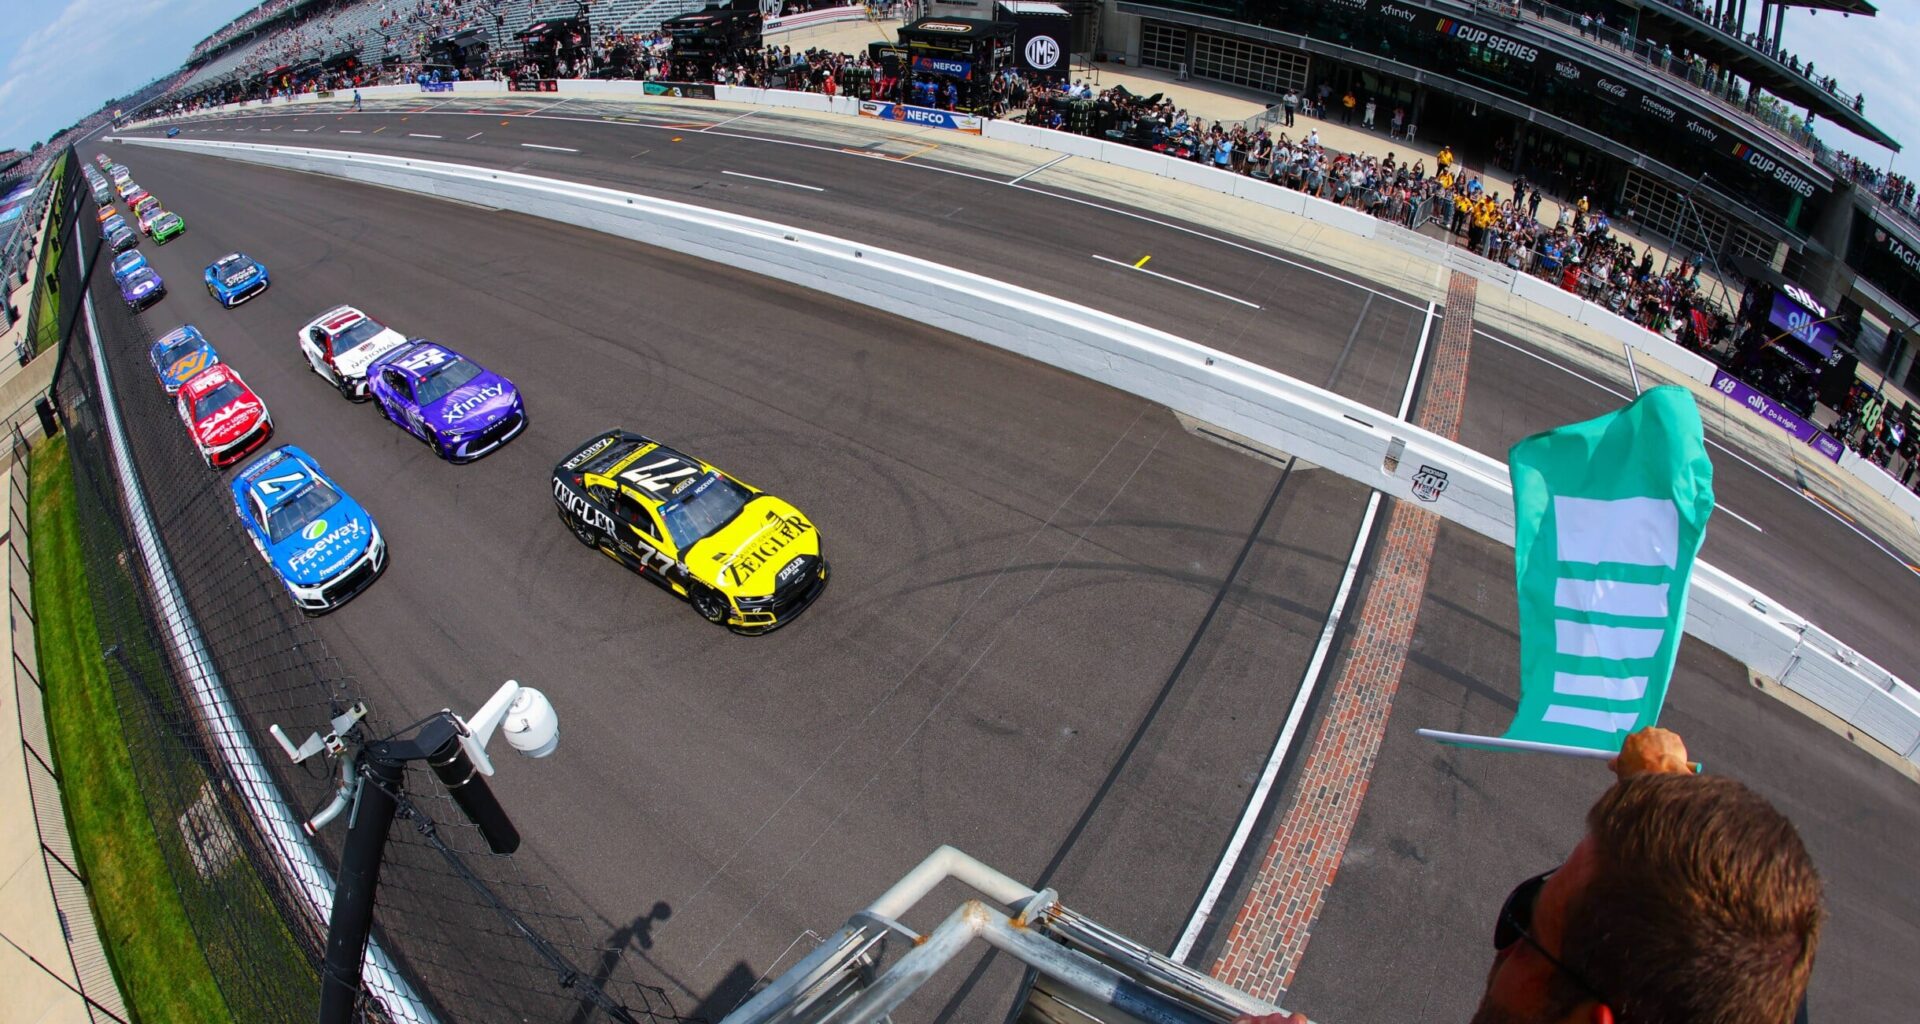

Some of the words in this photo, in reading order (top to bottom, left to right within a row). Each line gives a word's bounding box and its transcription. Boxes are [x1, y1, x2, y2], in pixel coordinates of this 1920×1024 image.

[1380, 5, 1416, 22] xfinity
[1031, 40, 1054, 61] IMS
[1456, 25, 1488, 45] CUP
[1487, 35, 1539, 63] SERIES
[933, 62, 962, 73] NEFCO
[1555, 62, 1580, 79] BUSCH
[907, 110, 944, 125] NEFCO
[1642, 95, 1676, 118] Freeway
[1686, 120, 1718, 142] xfinity
[1749, 153, 1775, 173] CUP
[1774, 167, 1815, 199] SERIES
[1889, 237, 1920, 273] TAGH
[1788, 311, 1821, 344] ally
[351, 342, 396, 369] NATIONAL
[199, 400, 258, 440] SAIA
[442, 383, 503, 424] xfinity
[1717, 378, 1737, 394] 48
[1748, 395, 1769, 413] ally
[1768, 410, 1778, 418] Do
[1782, 417, 1798, 433] right.
[1861, 398, 1882, 433] 48
[562, 438, 609, 469] ZEIGLER
[257, 472, 305, 495] 7
[619, 457, 699, 492] 77
[694, 476, 716, 494] HOCEVAR
[1412, 472, 1449, 491] 400
[552, 476, 619, 540] ZEIGLER
[288, 518, 360, 572] Freeway
[297, 526, 368, 580] INSURANCE
[637, 540, 675, 577] 77
[722, 515, 812, 587] ZEIGLER
[778, 556, 806, 581] ZEIGLER
